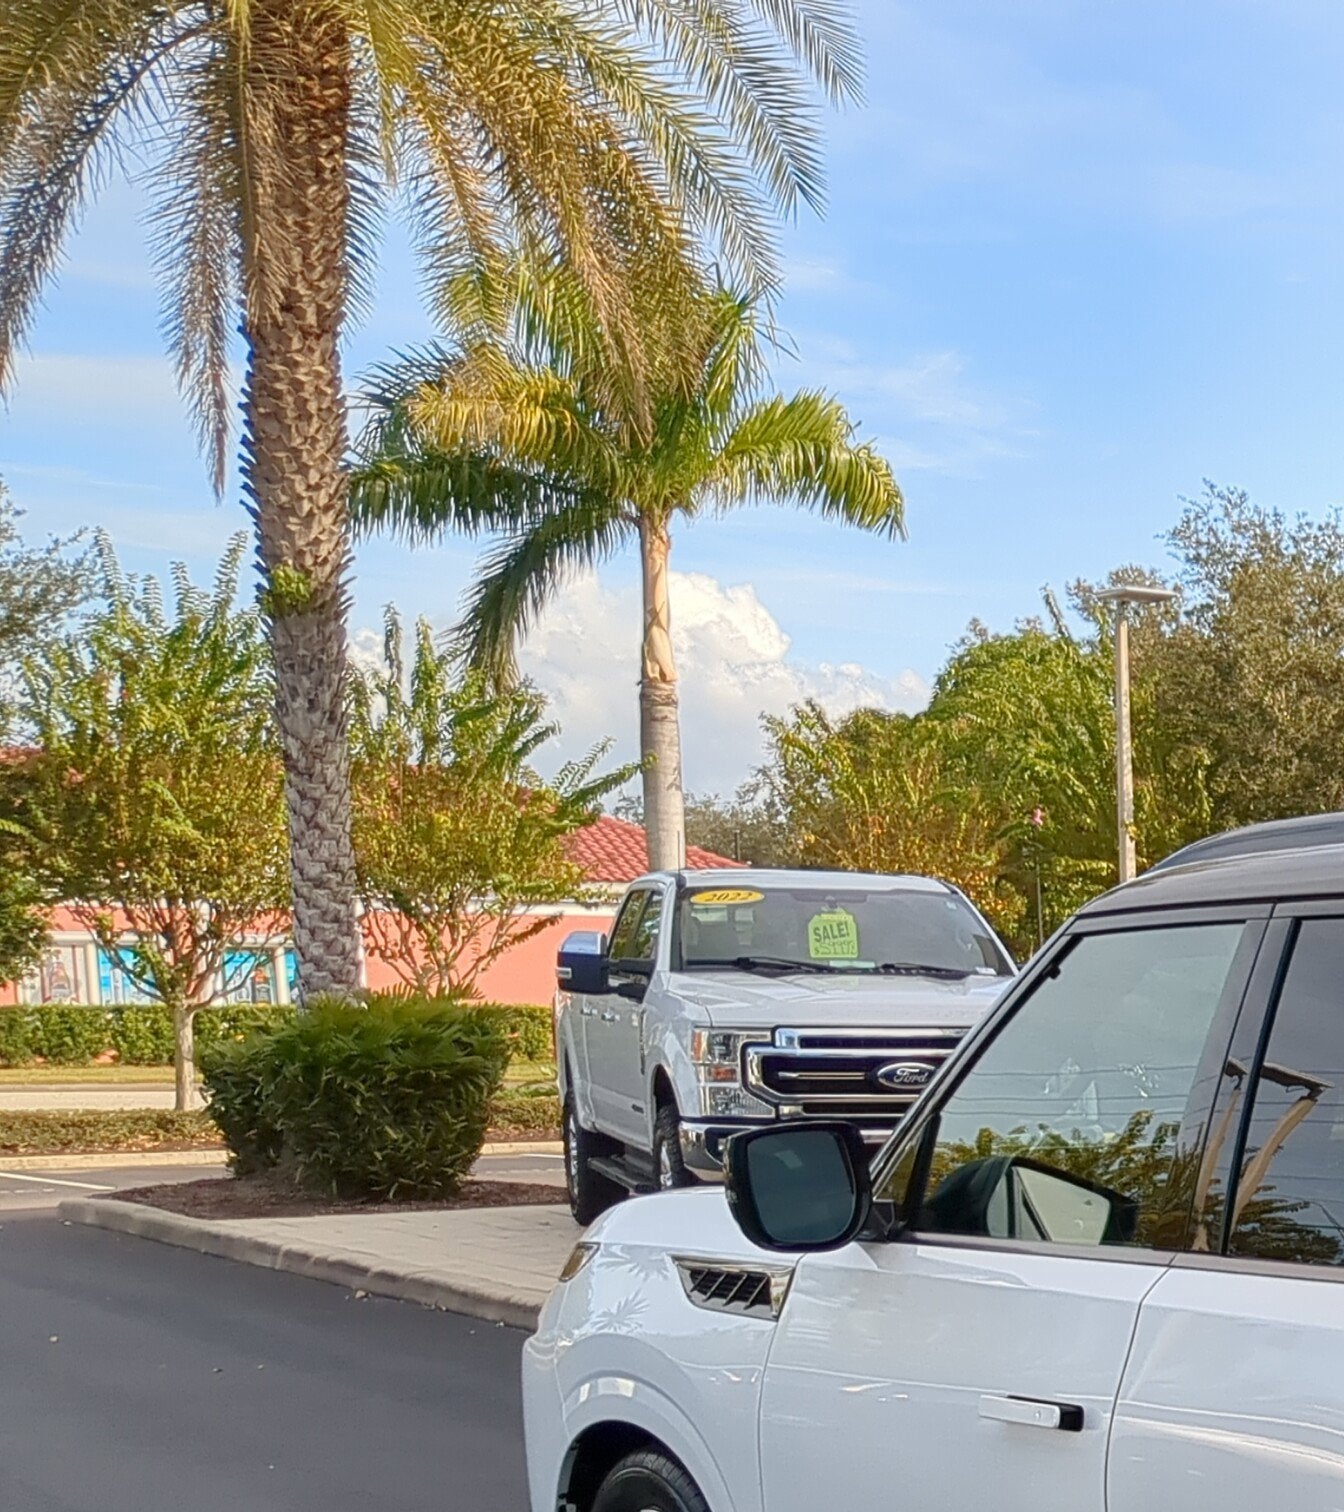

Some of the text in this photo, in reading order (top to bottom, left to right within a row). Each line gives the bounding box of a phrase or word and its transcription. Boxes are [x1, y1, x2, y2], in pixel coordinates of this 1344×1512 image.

[703, 891, 752, 903] 2022
[813, 920, 850, 944] SALE!
[893, 1067, 930, 1083] Ford
